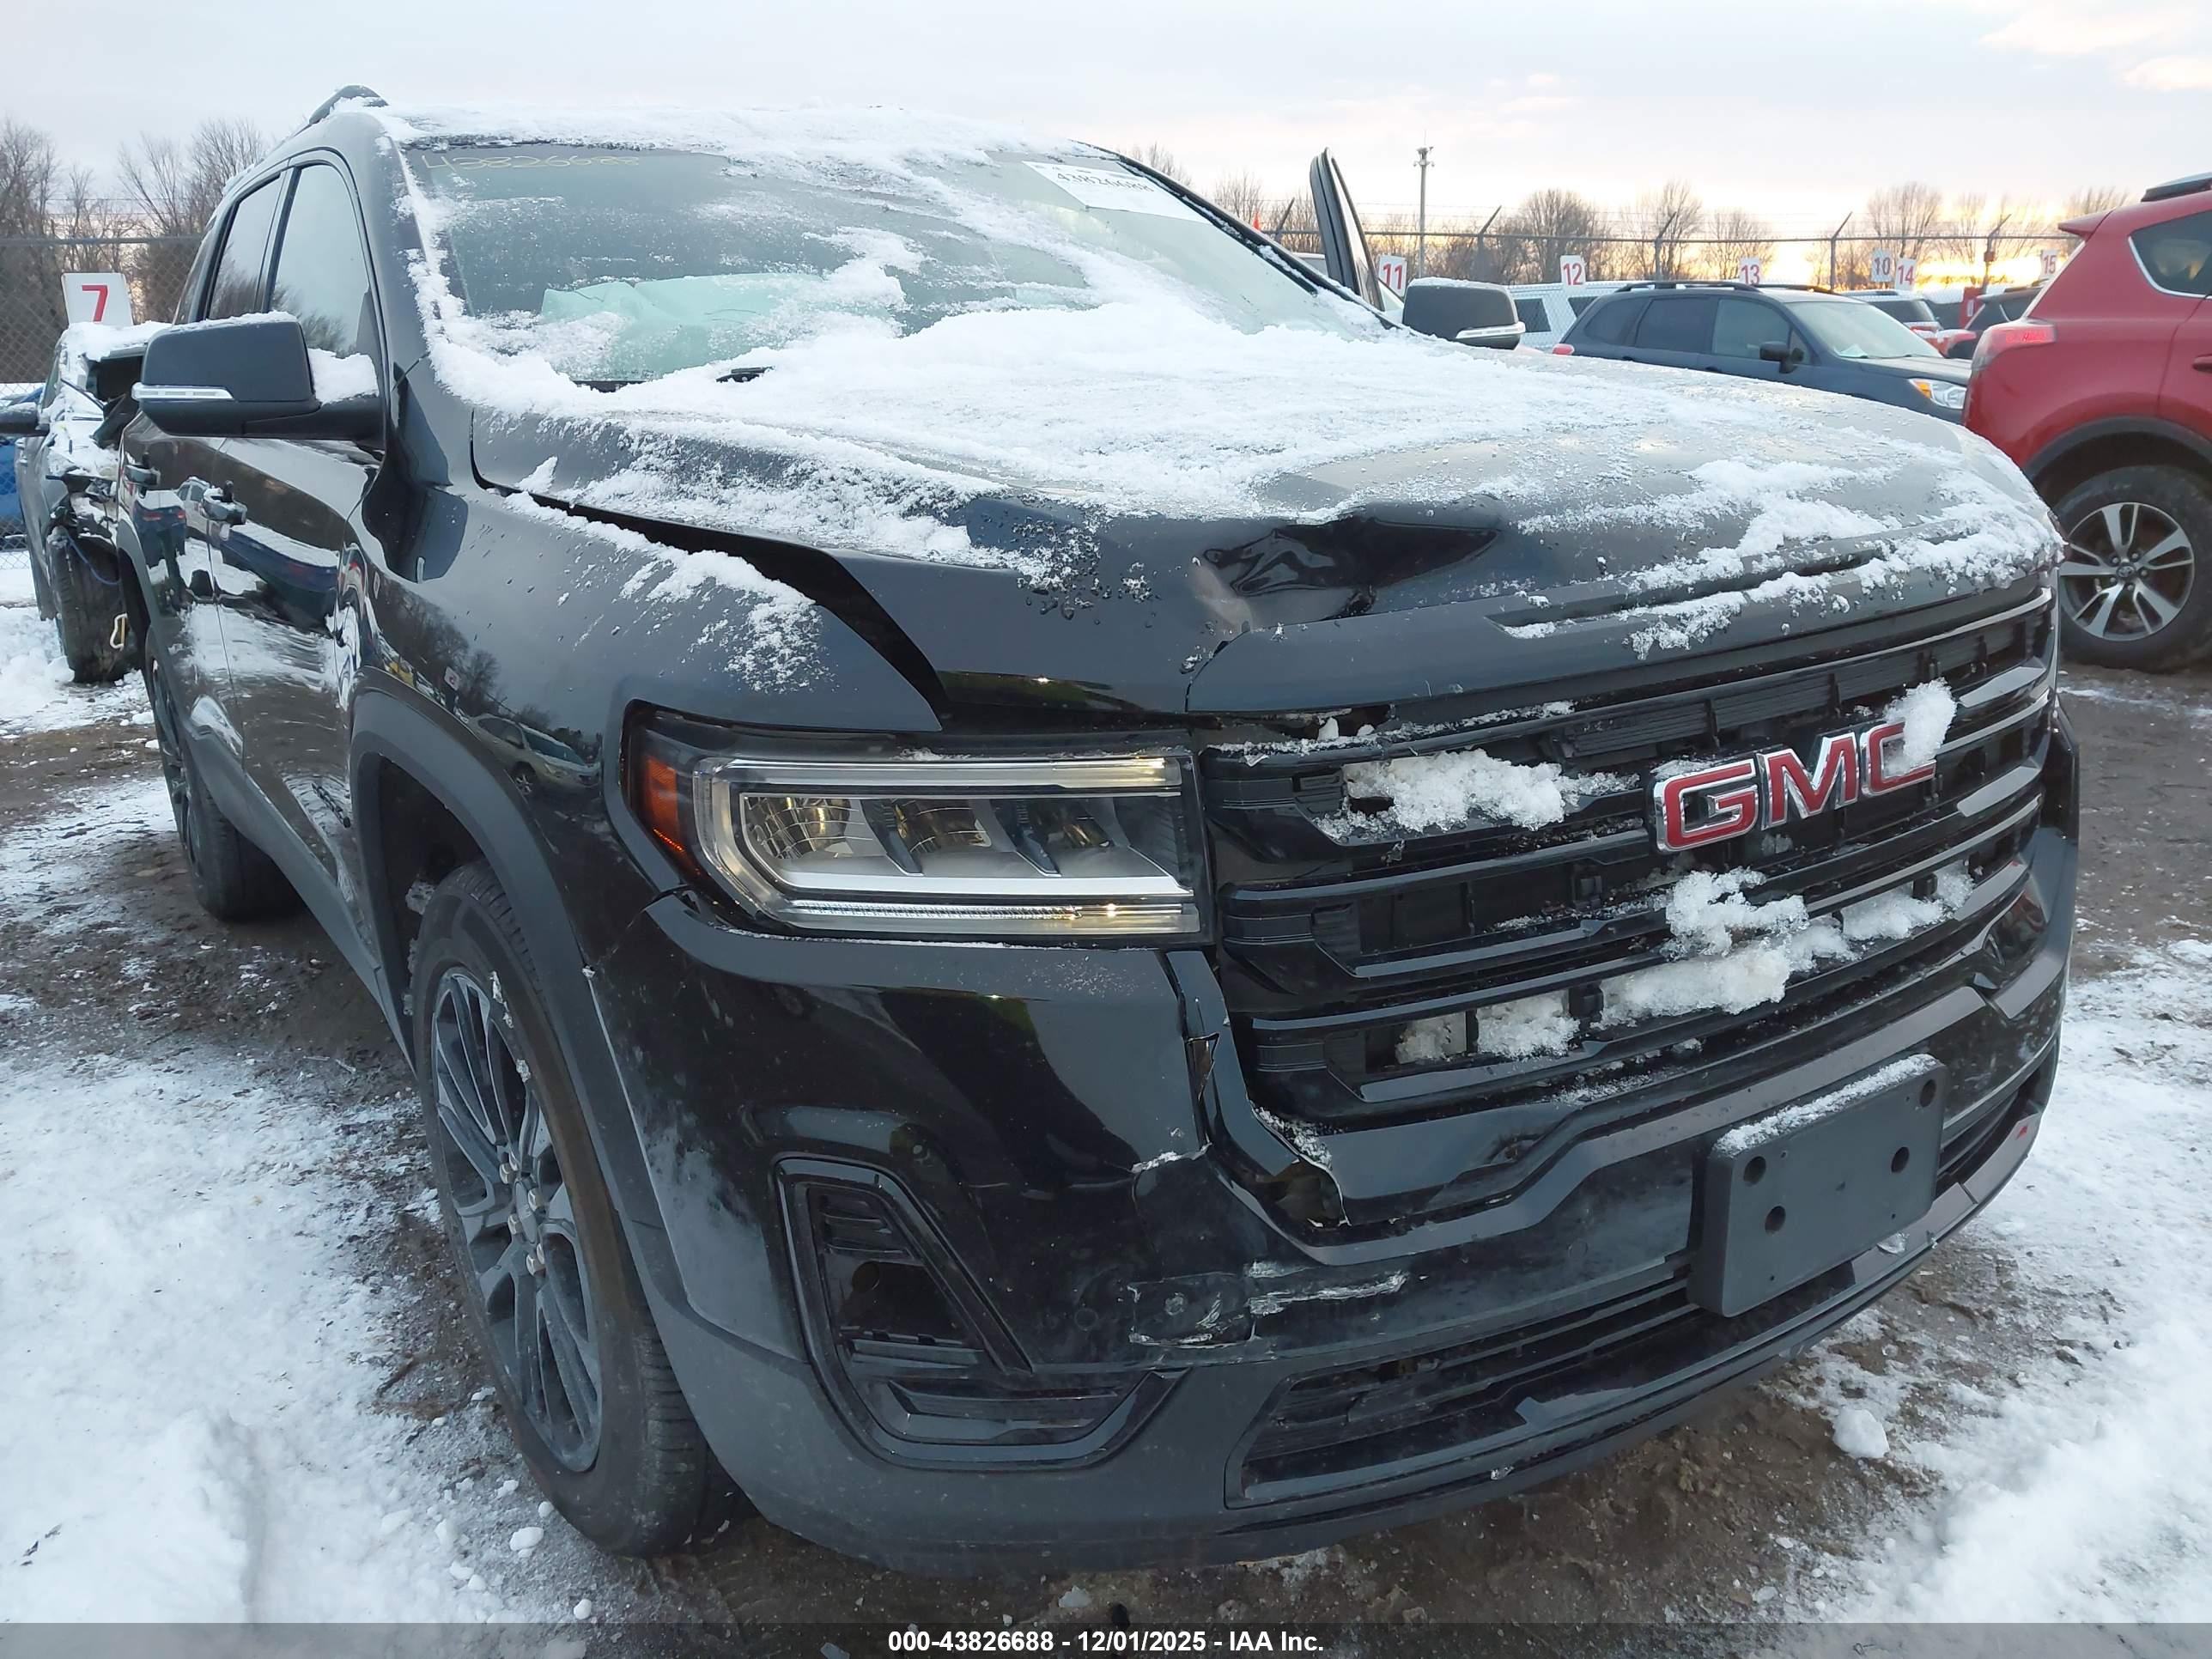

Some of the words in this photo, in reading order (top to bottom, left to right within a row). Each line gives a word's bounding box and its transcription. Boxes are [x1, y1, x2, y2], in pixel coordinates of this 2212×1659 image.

[1563, 263, 1583, 286] 12
[1741, 264, 1760, 286] 13
[1874, 257, 1891, 276] 10
[1898, 264, 1914, 286] 14
[2044, 255, 2057, 275] 15
[1383, 263, 1402, 290] 11
[82, 284, 108, 322] 7
[1654, 720, 1937, 853] GMC
